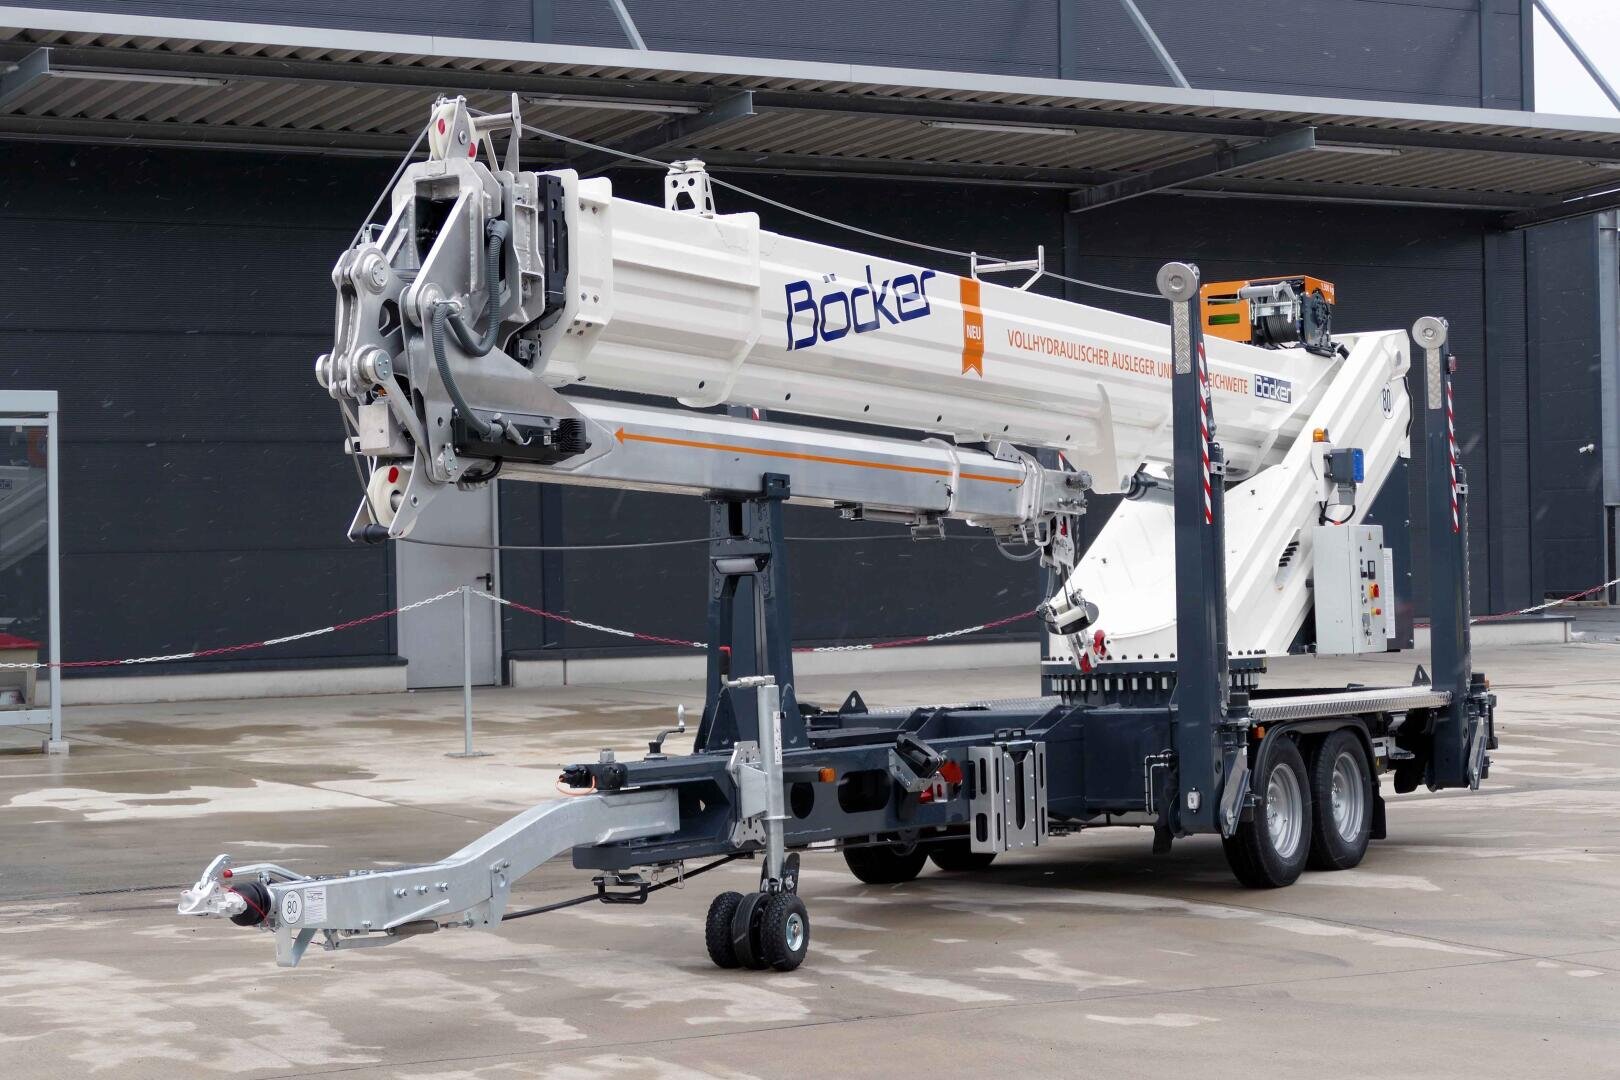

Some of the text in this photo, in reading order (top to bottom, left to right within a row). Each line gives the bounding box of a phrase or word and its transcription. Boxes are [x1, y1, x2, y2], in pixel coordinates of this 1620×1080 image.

[784, 264, 936, 351] Böcker
[966, 324, 981, 340] NEU
[1007, 329, 1110, 367] VOLLHYDRAULISCHER
[1111, 351, 1156, 377] AUSLEGER
[1208, 372, 1248, 394] EICHWEITE
[1255, 375, 1292, 403] Böcker
[1382, 388, 1391, 412] 80
[287, 901, 297, 914] 80
